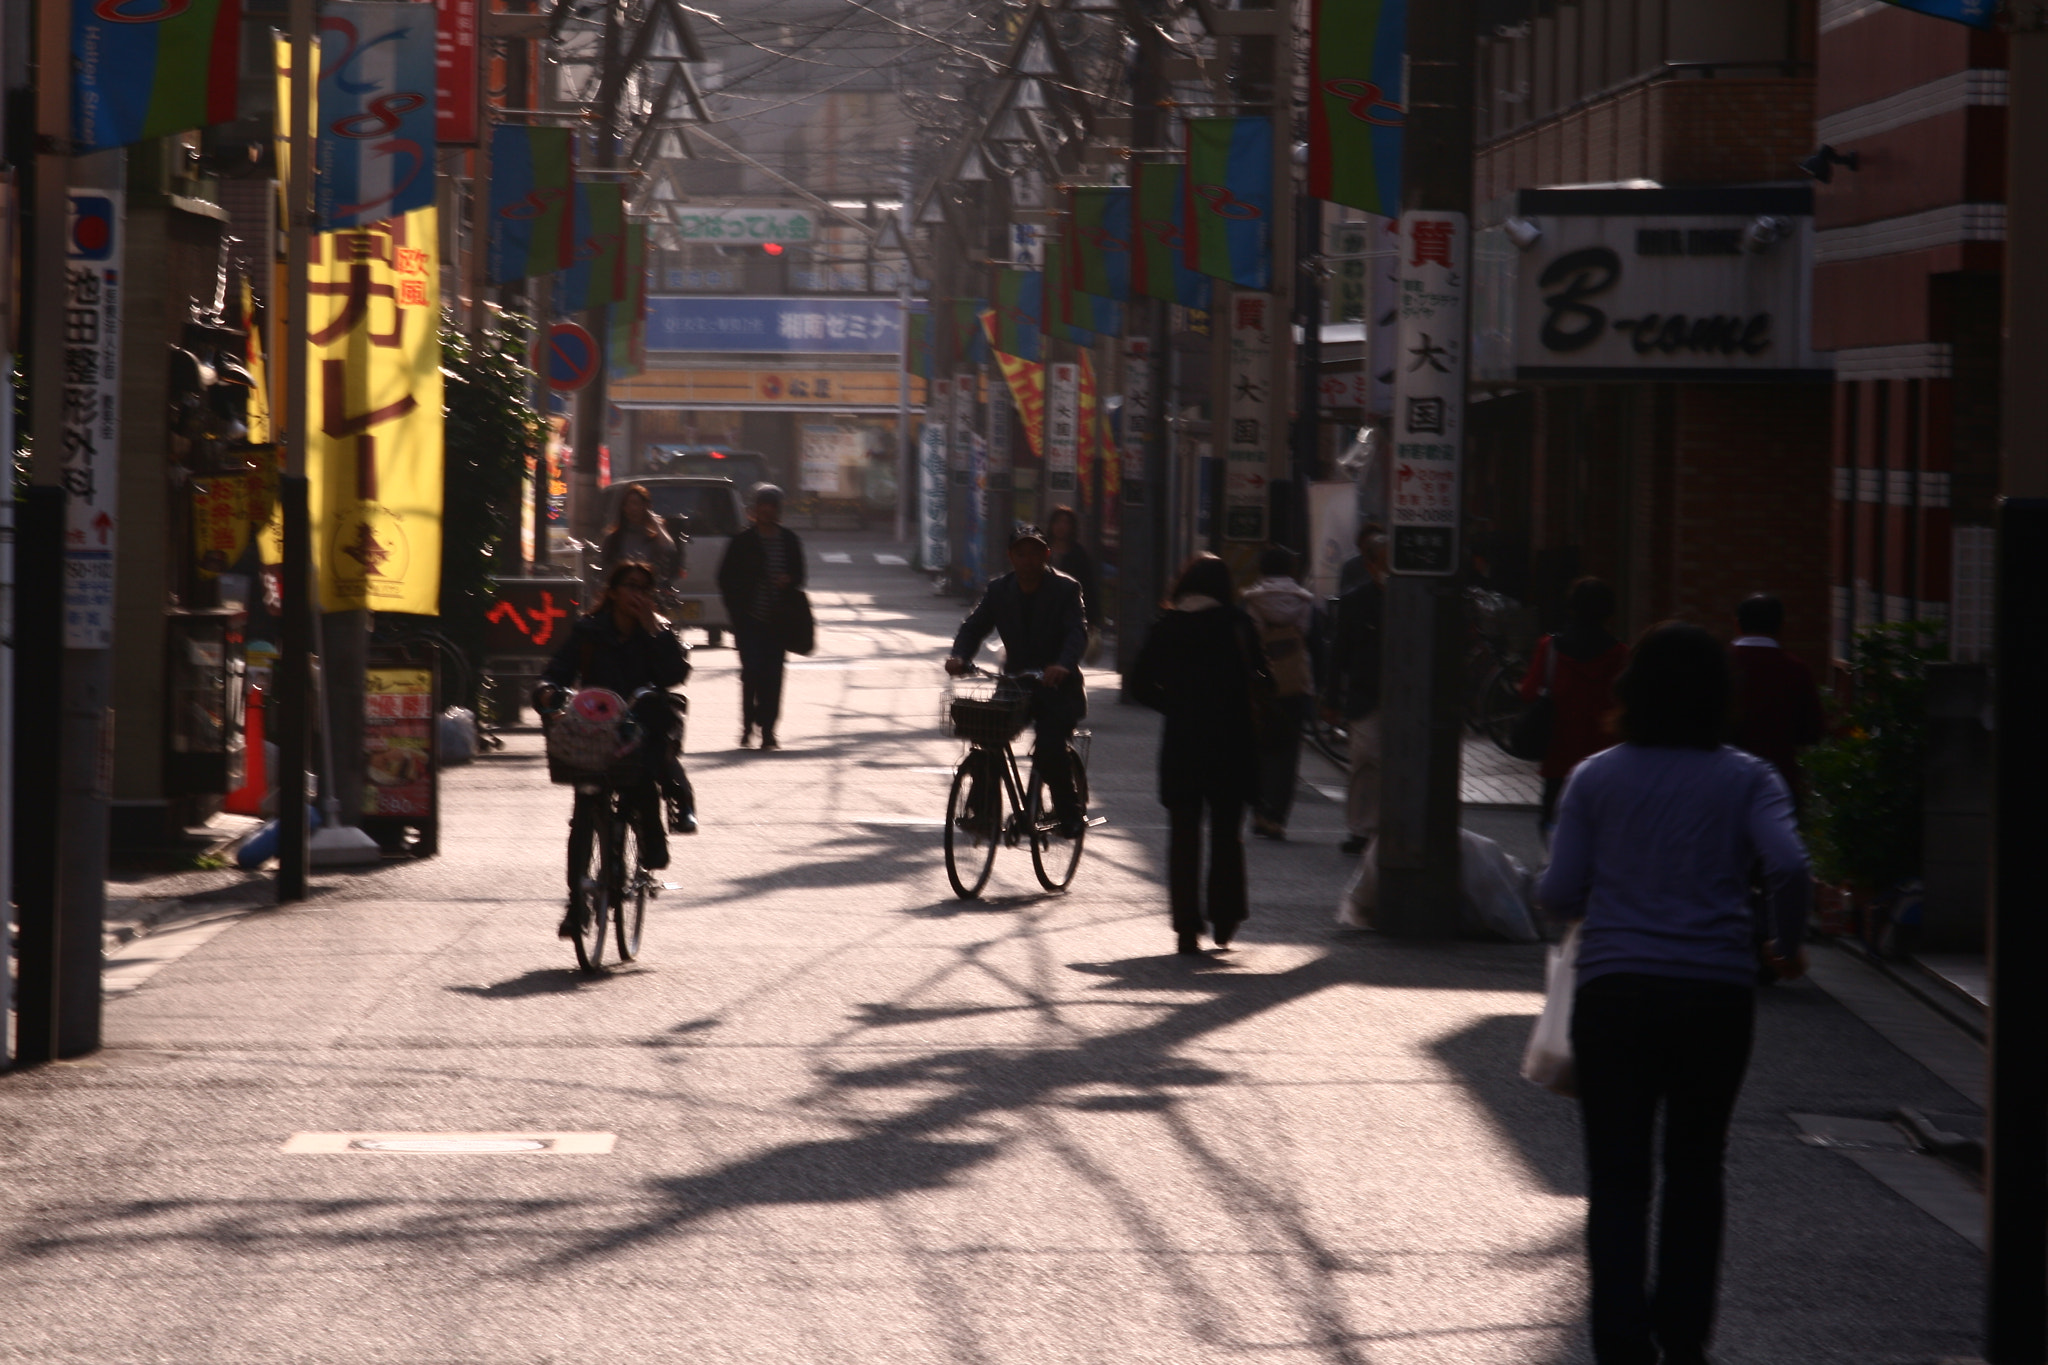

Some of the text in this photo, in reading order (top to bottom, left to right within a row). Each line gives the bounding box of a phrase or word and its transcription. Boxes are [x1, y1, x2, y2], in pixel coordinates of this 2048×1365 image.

[394, 245, 431, 308] 欧風
[1409, 219, 1457, 269] 質
[1538, 246, 1772, 356] B-come
[1407, 331, 1452, 436] 大国
